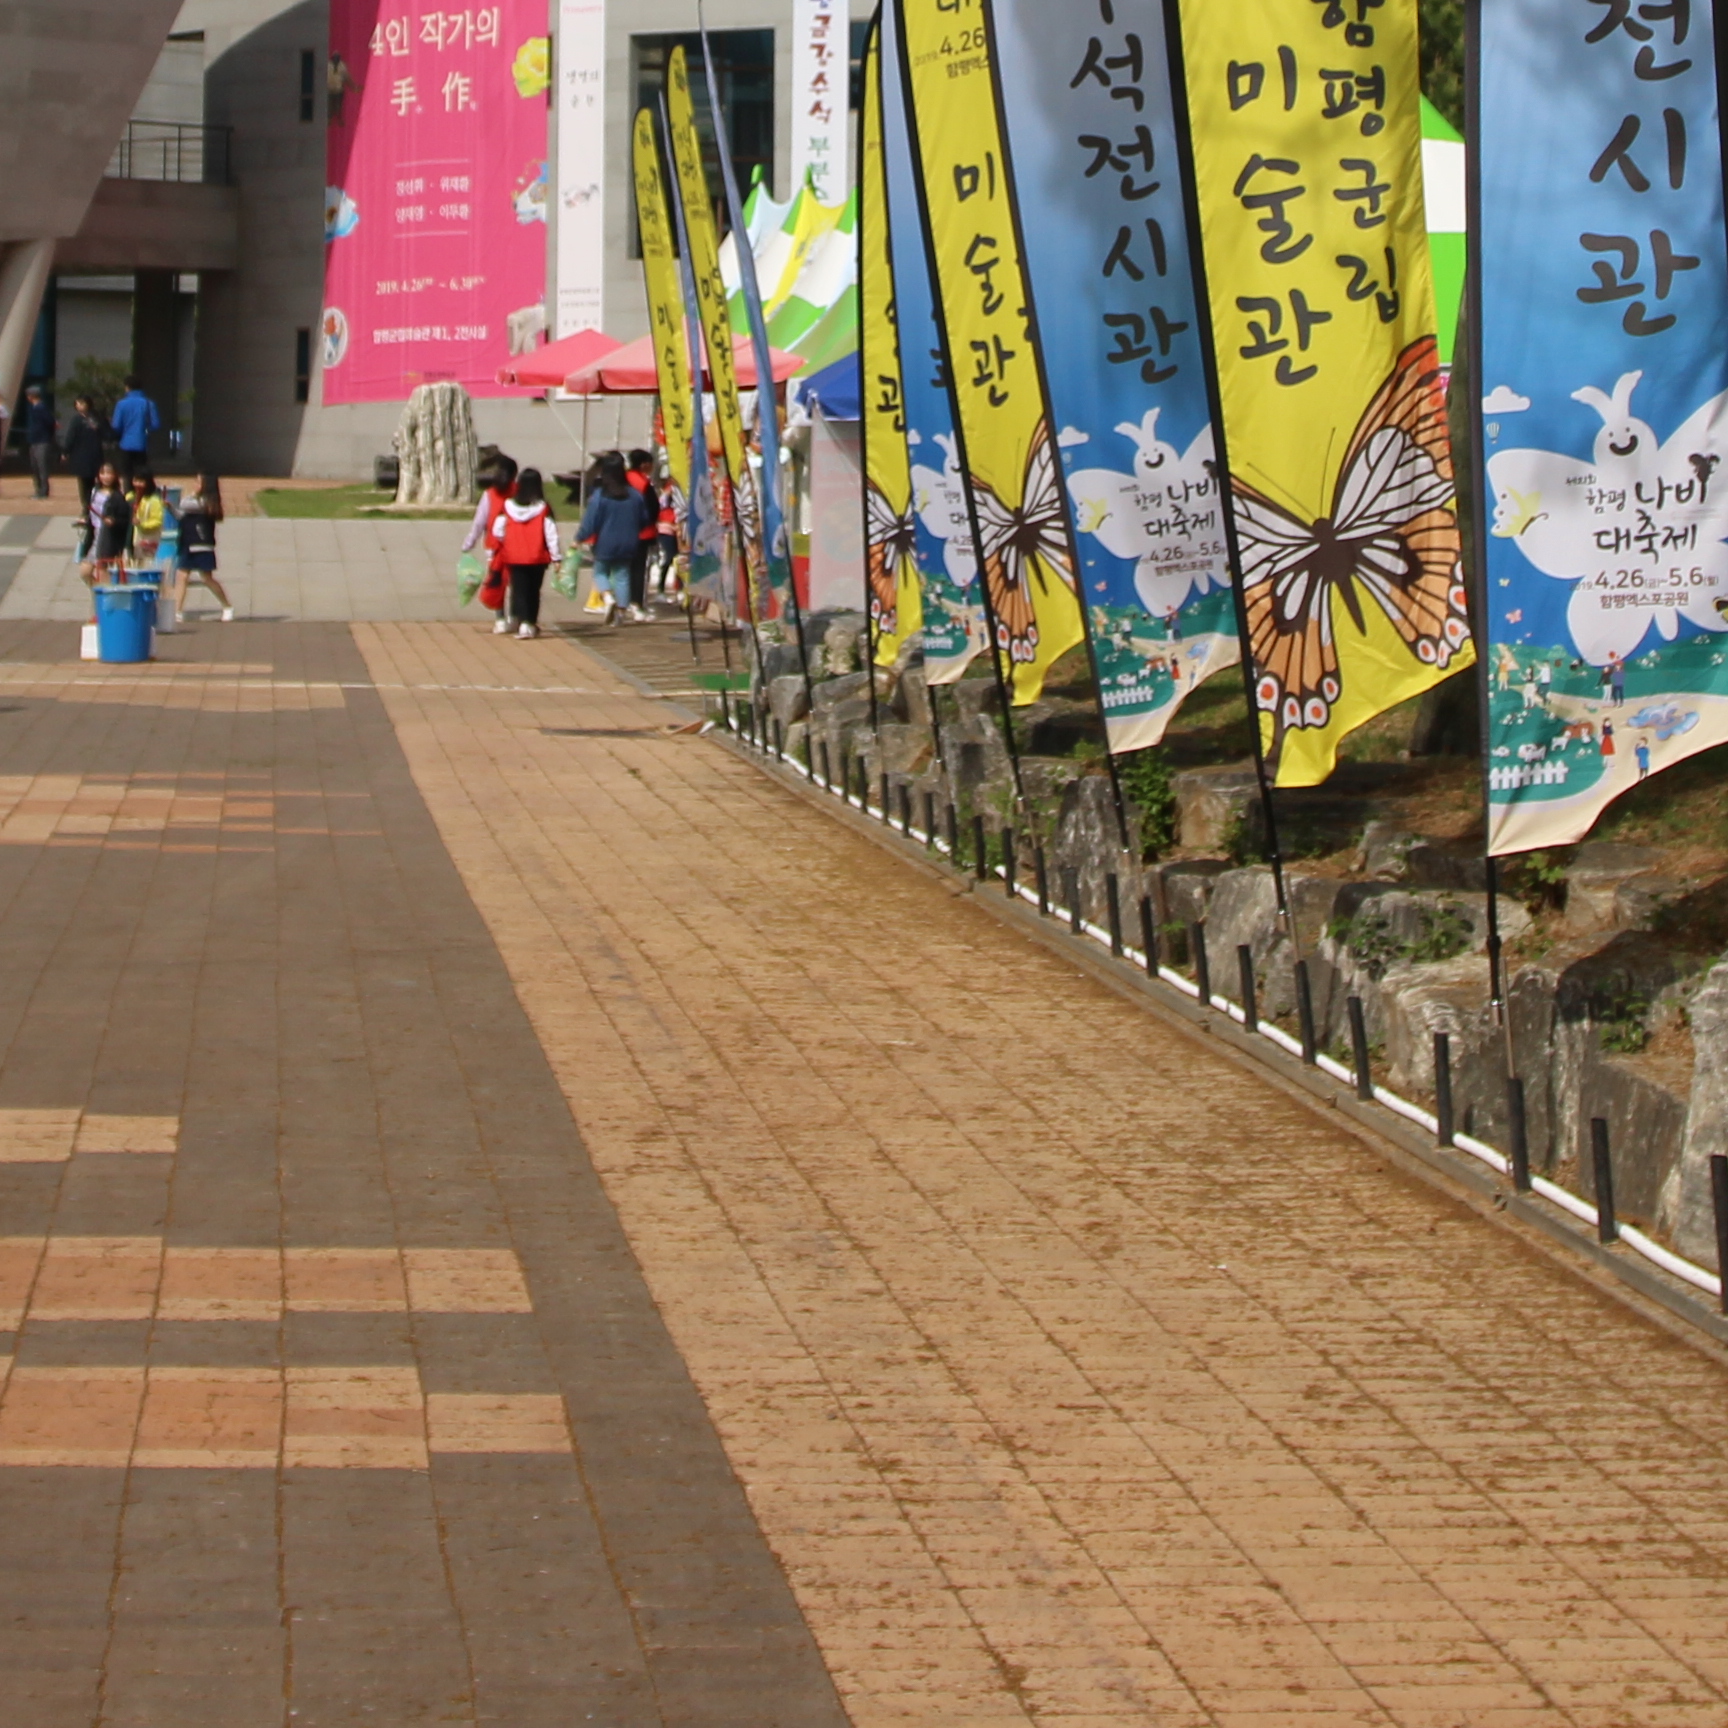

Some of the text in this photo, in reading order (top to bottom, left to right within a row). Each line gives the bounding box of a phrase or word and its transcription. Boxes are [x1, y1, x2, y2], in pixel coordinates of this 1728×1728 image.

[368, 6, 501, 57] 4인 작가의
[1227, 45, 1332, 387] 미술관
[1586, 472, 1710, 515] 함평 나비
[1143, 504, 1216, 542] 대축제
[1592, 509, 1698, 565] 대축제
